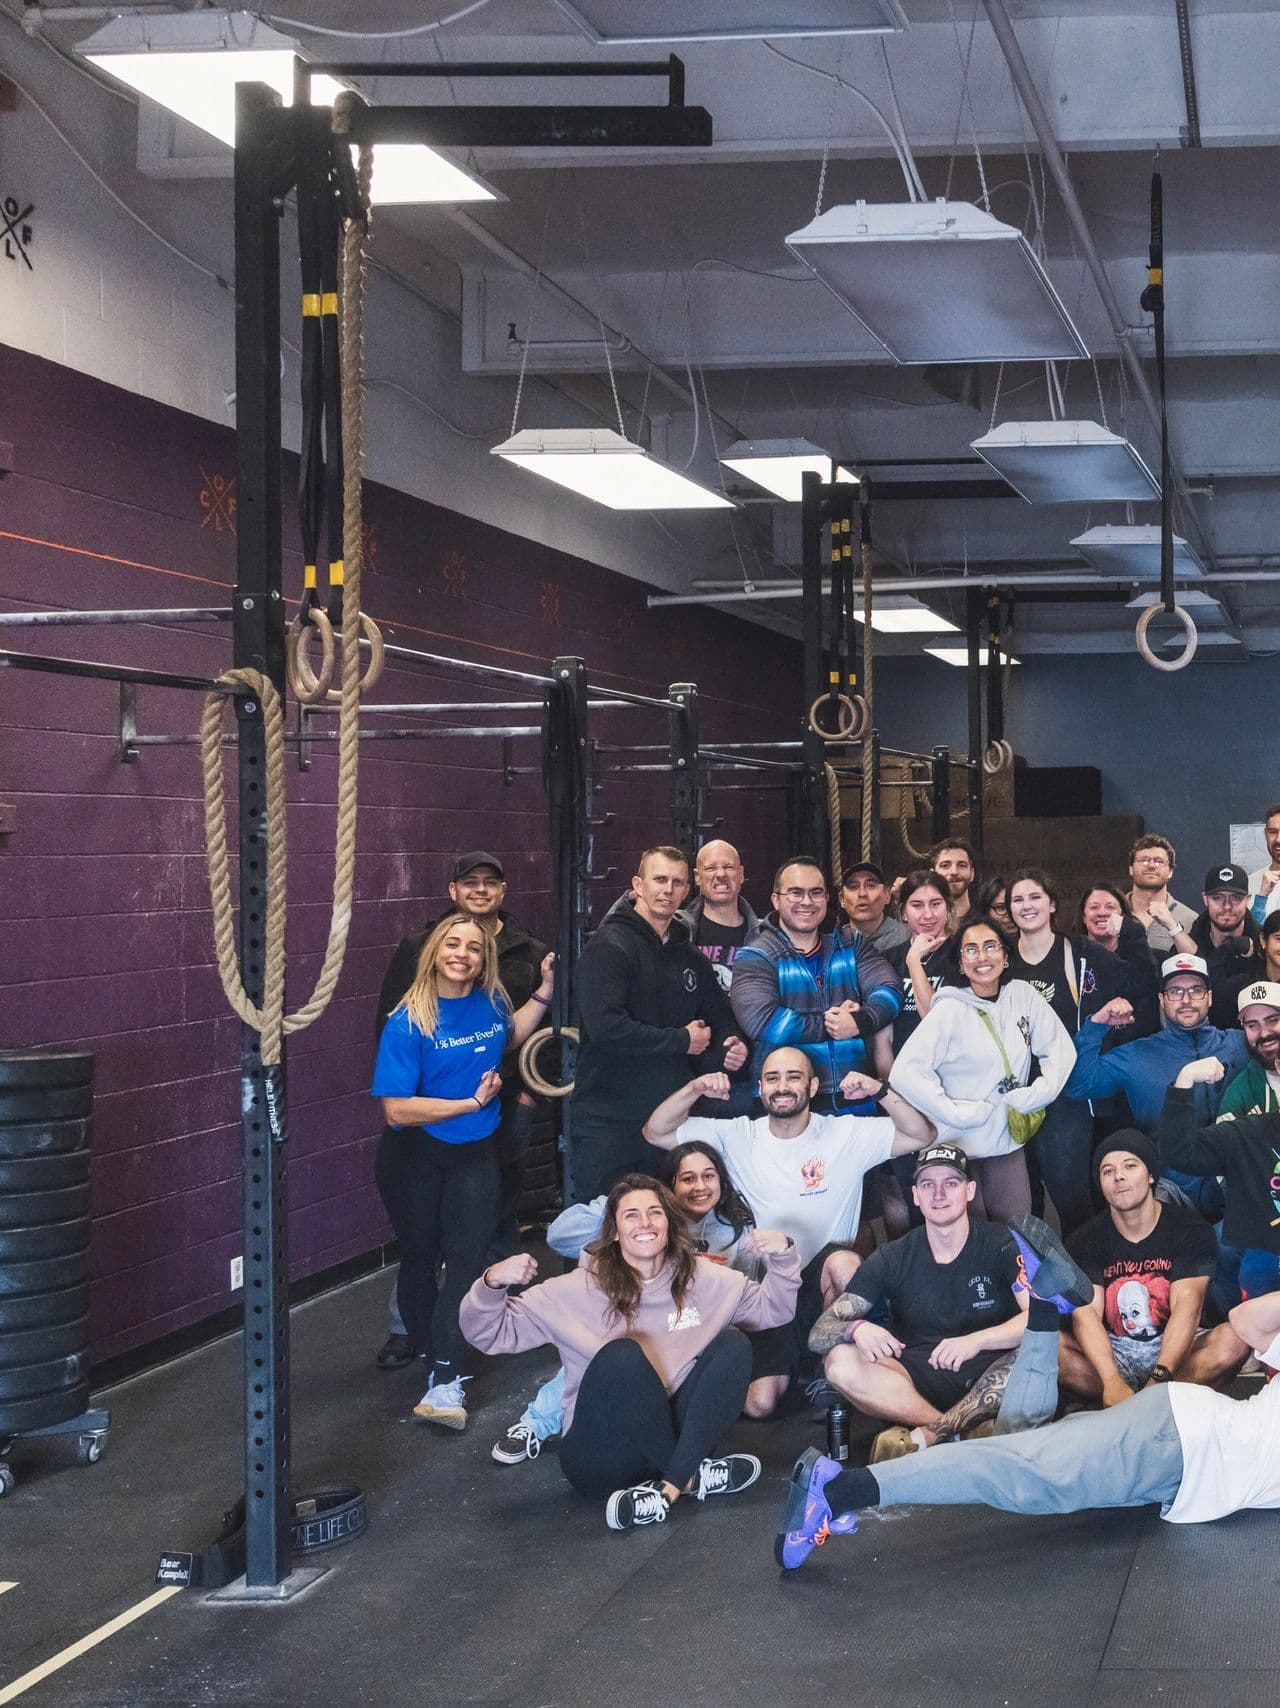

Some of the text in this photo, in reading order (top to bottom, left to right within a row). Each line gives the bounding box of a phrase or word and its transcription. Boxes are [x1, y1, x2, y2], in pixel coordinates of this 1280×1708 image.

[1251, 990, 1267, 1000] DAD
[449, 1035, 475, 1047] Better
[1123, 1260, 1143, 1273] YOU
[319, 1516, 344, 1544] LIFE
[160, 1558, 181, 1568] Bear
